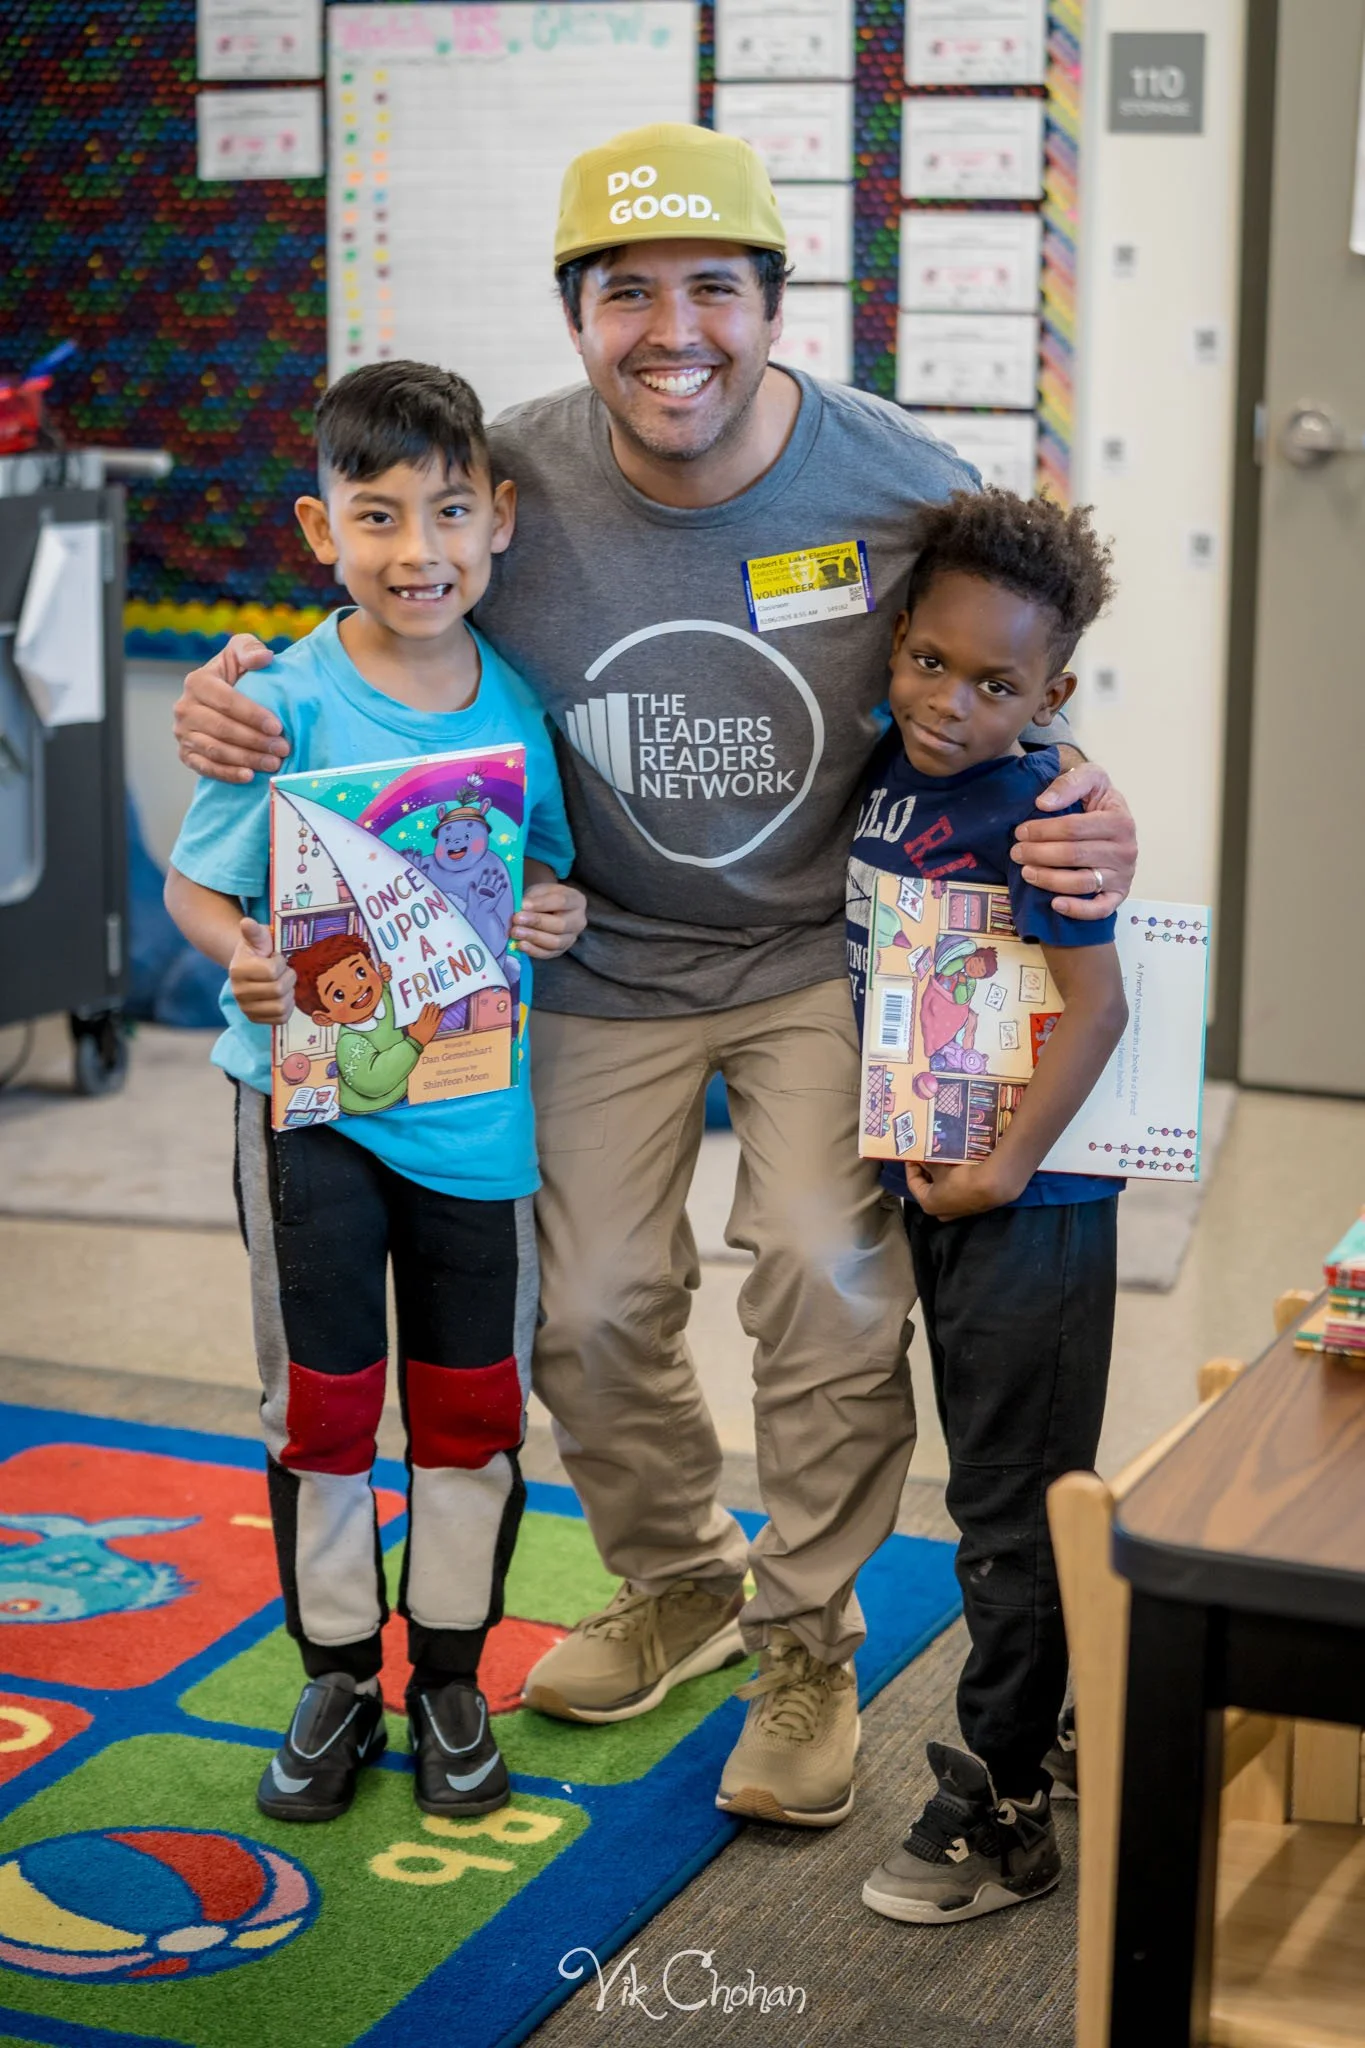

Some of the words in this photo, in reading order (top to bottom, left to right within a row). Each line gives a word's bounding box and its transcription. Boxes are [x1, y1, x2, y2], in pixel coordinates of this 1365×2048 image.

[1130, 65, 1185, 98] 110
[608, 165, 658, 196] DO
[609, 193, 720, 225] GOOD.
[751, 559, 777, 570] Robert
[787, 554, 806, 562] Lake
[808, 546, 851, 559] Elementary
[756, 582, 814, 599] VOLUNTEER
[631, 694, 686, 716] THE
[638, 716, 772, 744] LEADERS
[639, 744, 776, 772] READERS
[640, 770, 795, 800] NETWORK
[366, 867, 425, 920] ONCE
[377, 890, 449, 950] UPON
[420, 935, 437, 962] A
[399, 944, 486, 1009] FRIEND
[1134, 970, 1143, 997] friend
[421, 1055, 439, 1064] Dan
[441, 1045, 492, 1061] Gemeinhart
[465, 1072, 489, 1082] Moon
